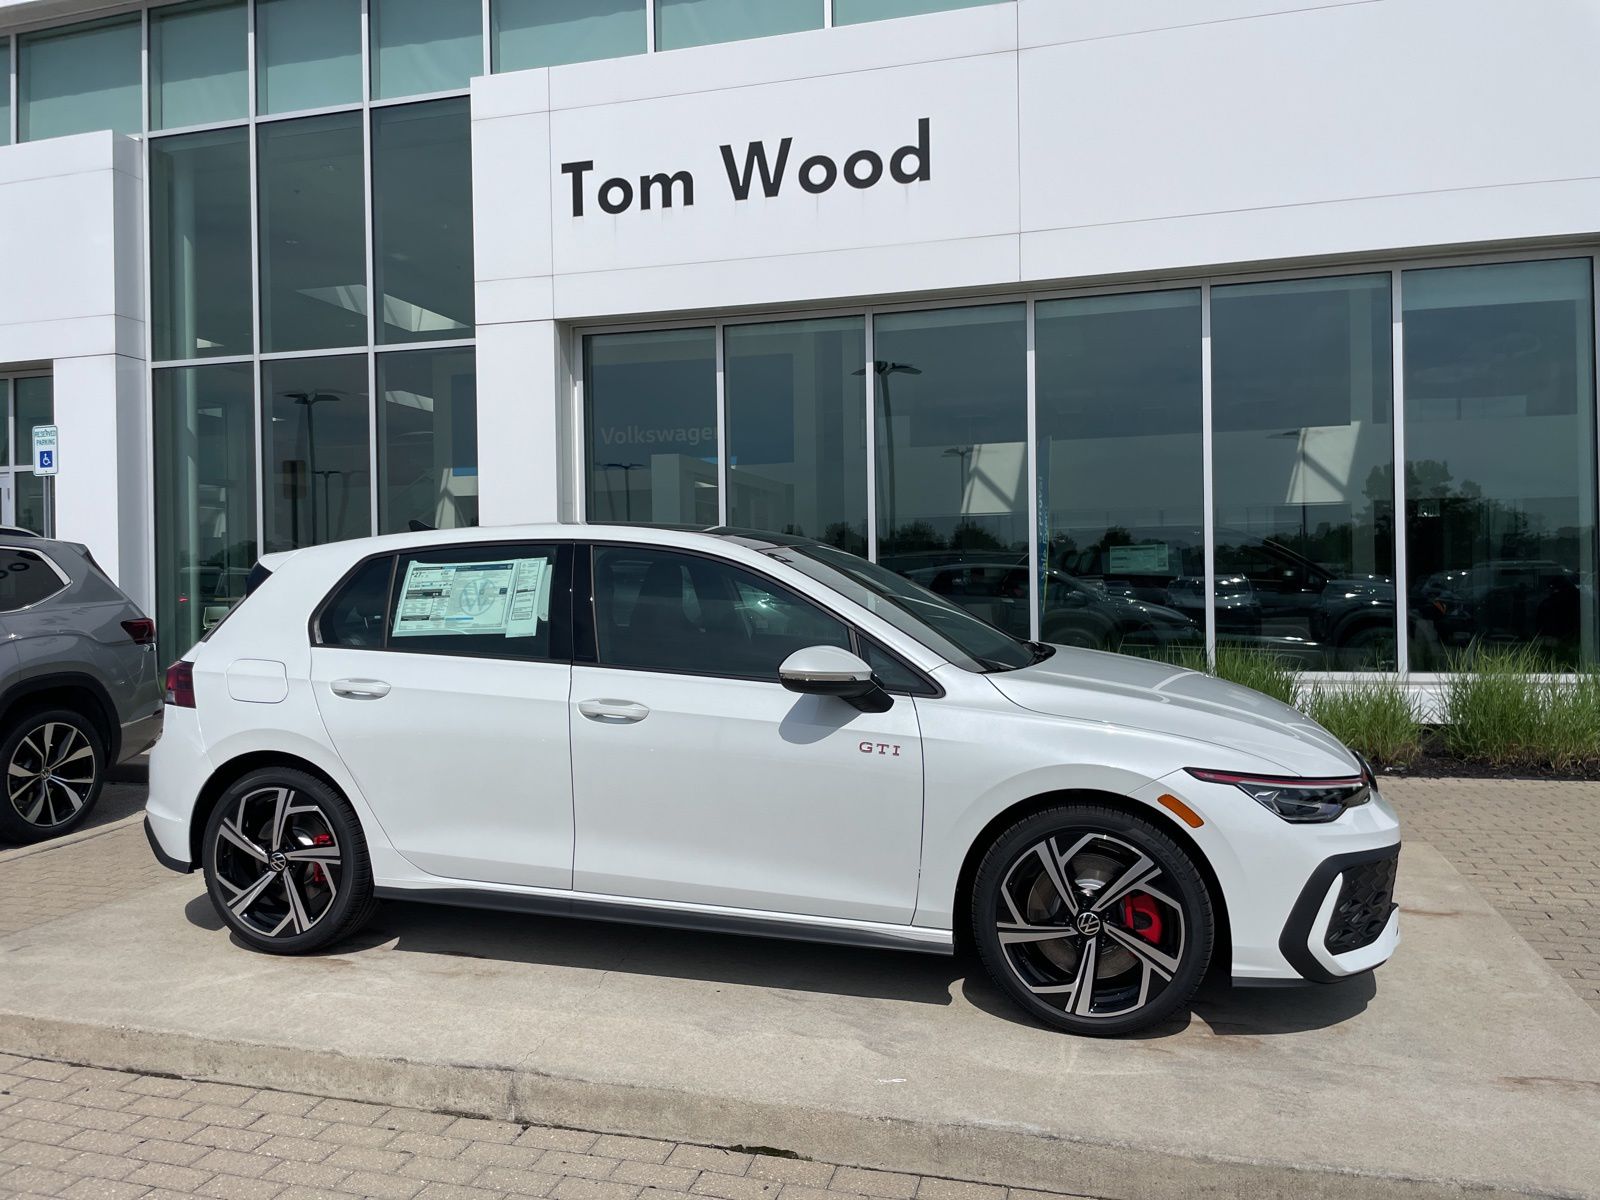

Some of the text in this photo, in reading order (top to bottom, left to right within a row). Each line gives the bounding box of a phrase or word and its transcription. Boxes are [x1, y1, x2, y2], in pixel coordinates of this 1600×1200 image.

[561, 117, 931, 217] Tom Wood
[36, 438, 55, 446] PARKING
[600, 425, 718, 446] Volkswage
[859, 741, 901, 756] GTI
